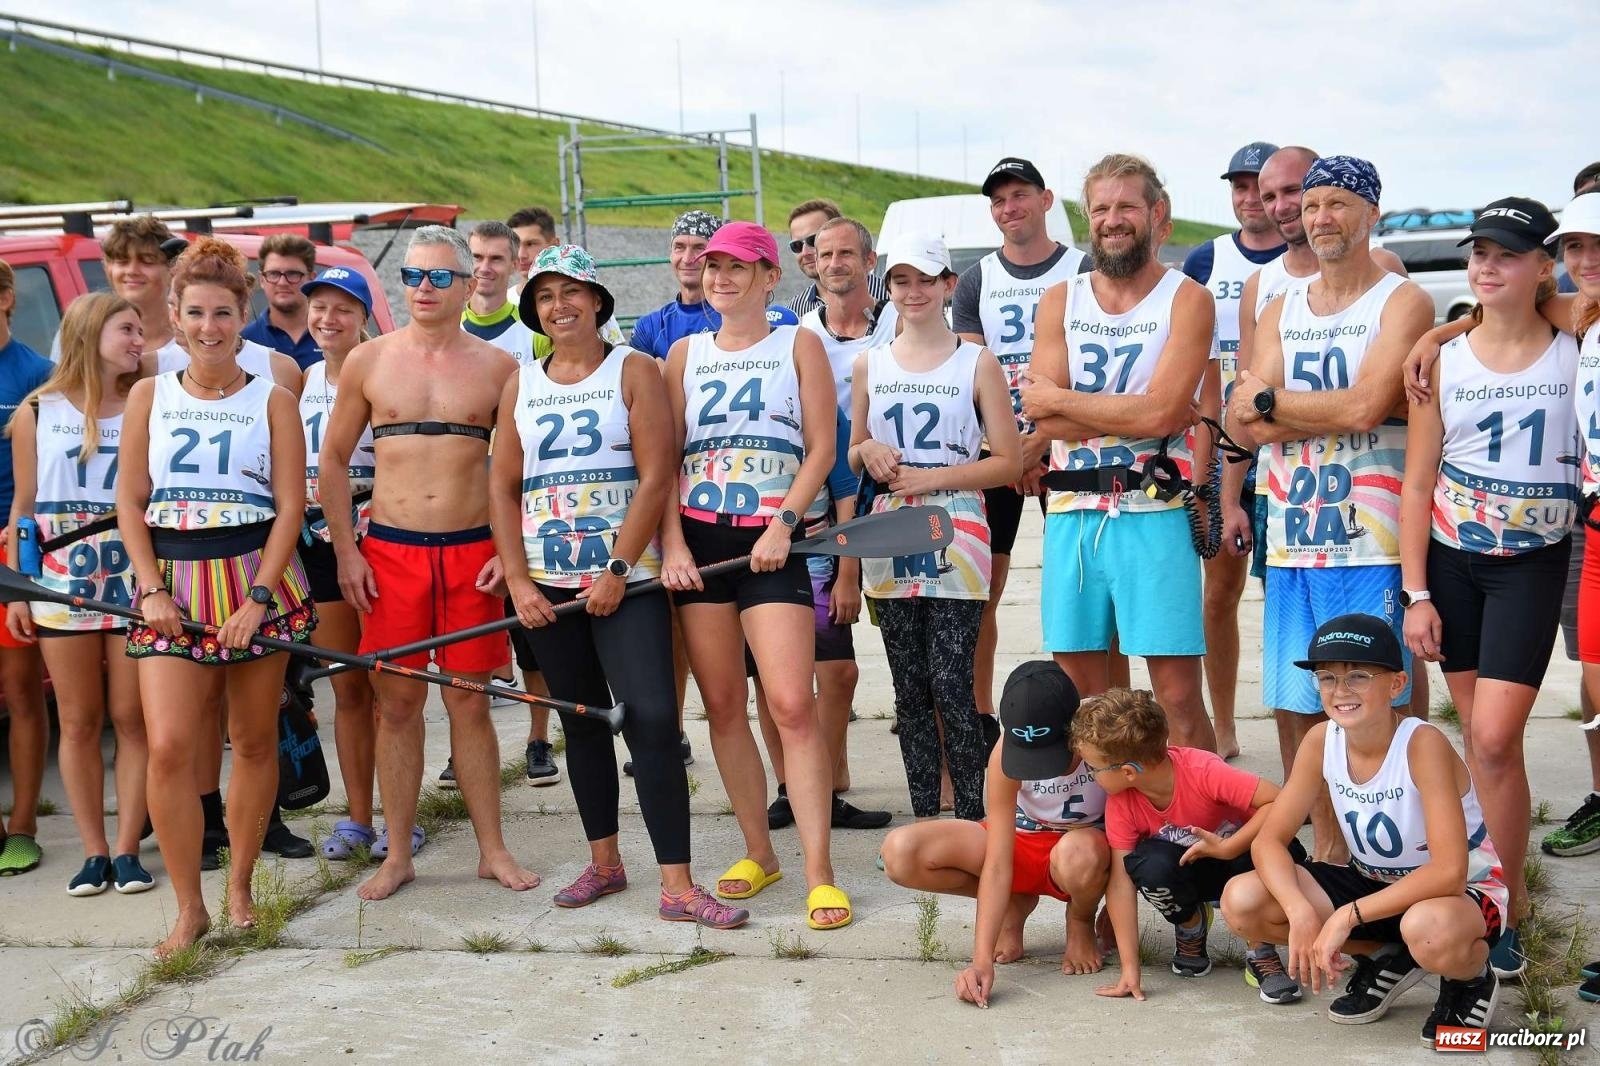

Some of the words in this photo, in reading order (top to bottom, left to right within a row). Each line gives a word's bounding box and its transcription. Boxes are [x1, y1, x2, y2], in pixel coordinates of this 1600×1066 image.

[989, 286, 1046, 299] #odrasup
[1215, 280, 1245, 299] 33
[999, 303, 1039, 344] 3
[1070, 318, 1158, 338] #odrasupcup
[1283, 323, 1367, 341] #odrasupcup
[696, 359, 780, 376] #odrasupcup
[1002, 355, 1031, 364] 1-3.09
[1074, 343, 1144, 394] 37
[1292, 346, 1349, 392] 50
[527, 389, 615, 409] #odrasupcup
[697, 377, 766, 427] 24
[874, 381, 960, 397] #odrasupcup
[1455, 383, 1569, 402] #odrasupcup
[162, 408, 255, 426] #odrasupcup
[883, 402, 942, 450] 12
[169, 427, 232, 476] 21
[535, 409, 603, 462] 23
[1476, 409, 1546, 466] 11
[65, 444, 119, 490] 17
[541, 471, 613, 488] 1-3.09.2023
[1287, 463, 1352, 506] OD
[166, 490, 244, 501] 1-3.09.2023
[688, 481, 760, 516] OD
[1464, 475, 1554, 497] 1-3.09.2023
[1285, 505, 1351, 547] RA
[68, 540, 131, 578] OD
[1344, 810, 1404, 859] 10
